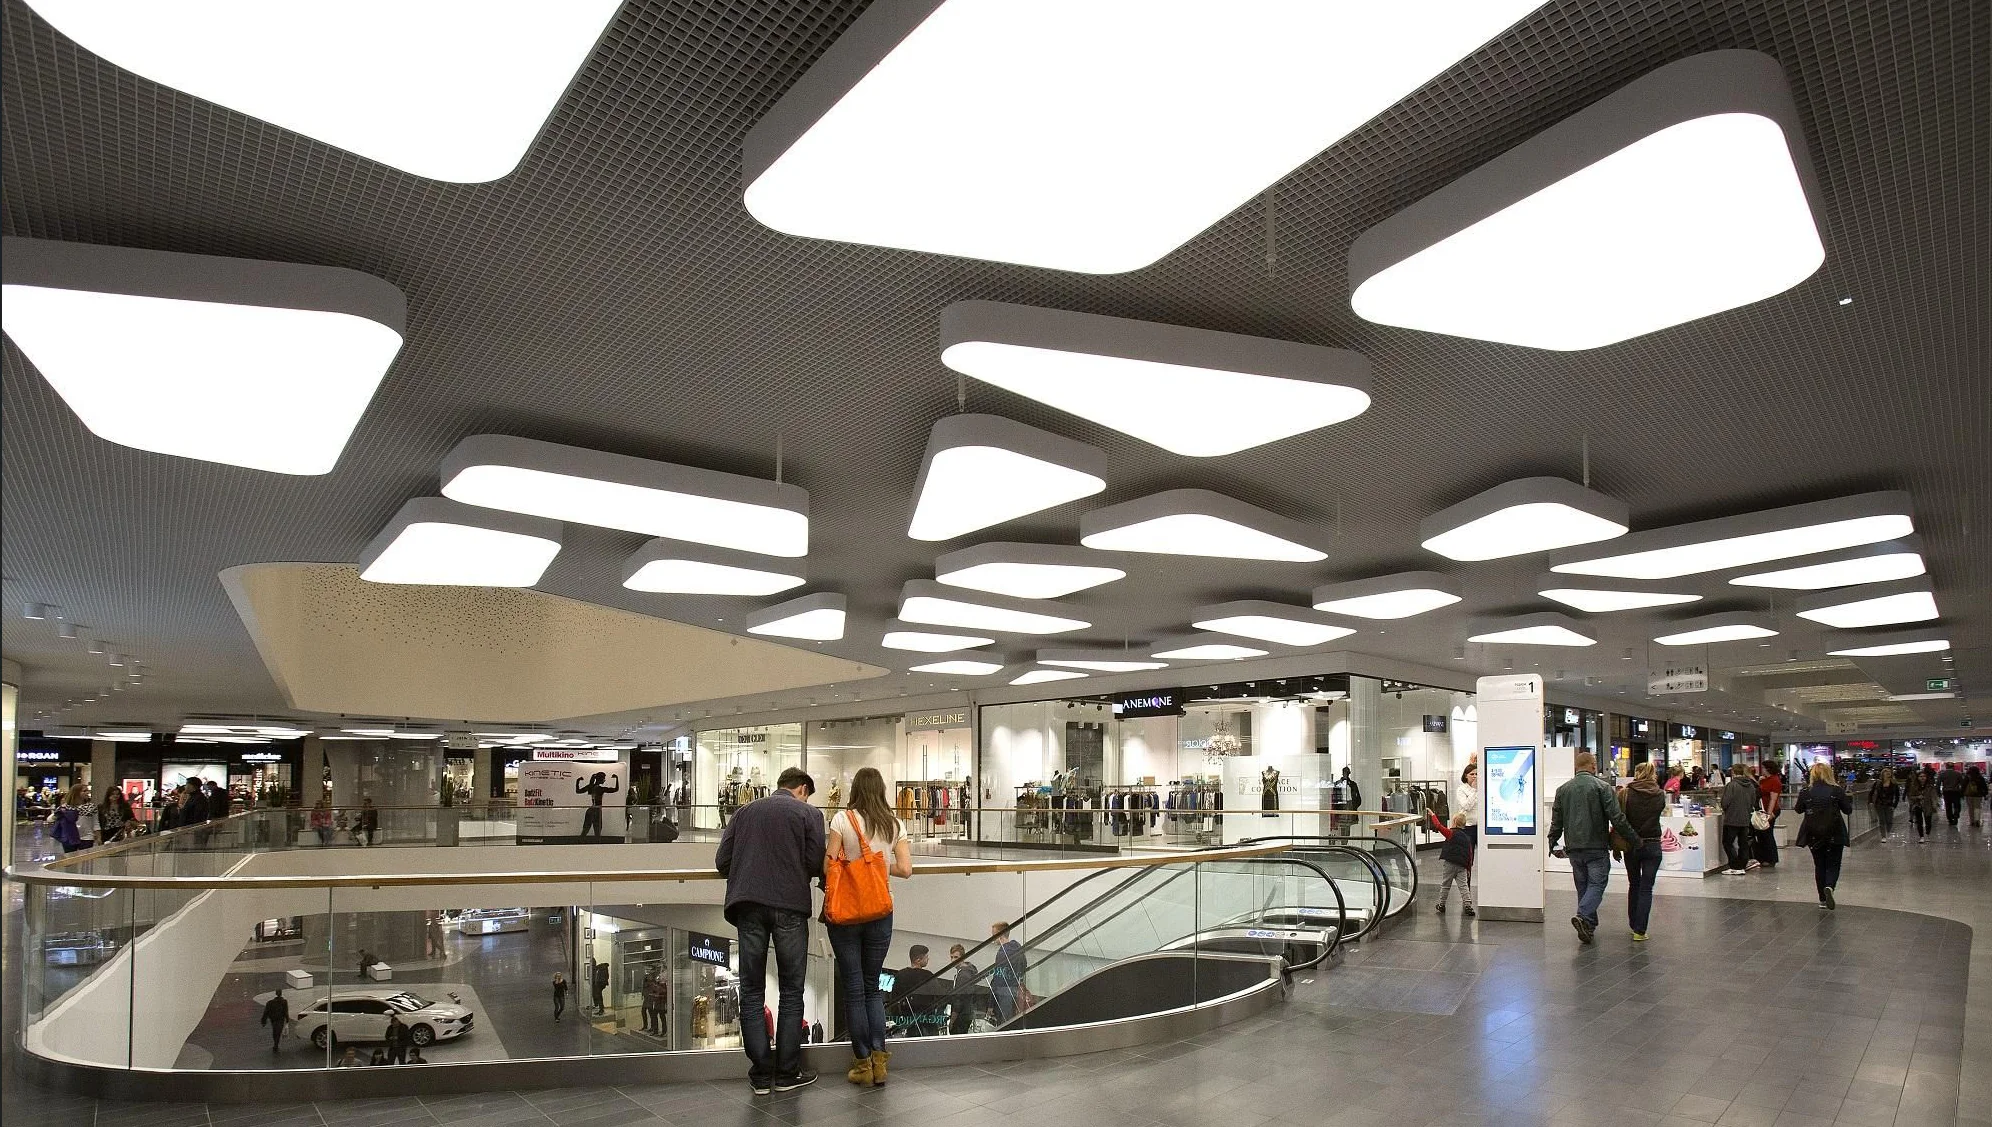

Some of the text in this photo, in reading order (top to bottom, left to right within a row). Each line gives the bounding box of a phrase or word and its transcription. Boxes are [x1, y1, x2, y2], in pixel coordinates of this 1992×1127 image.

[1528, 681, 1534, 693] 1
[1122, 696, 1173, 709] ANEMONE
[911, 713, 965, 726] HEXELINE
[537, 751, 574, 759] Multikino
[524, 769, 572, 778] KINETIC
[691, 945, 725, 963] CAMPIONE
